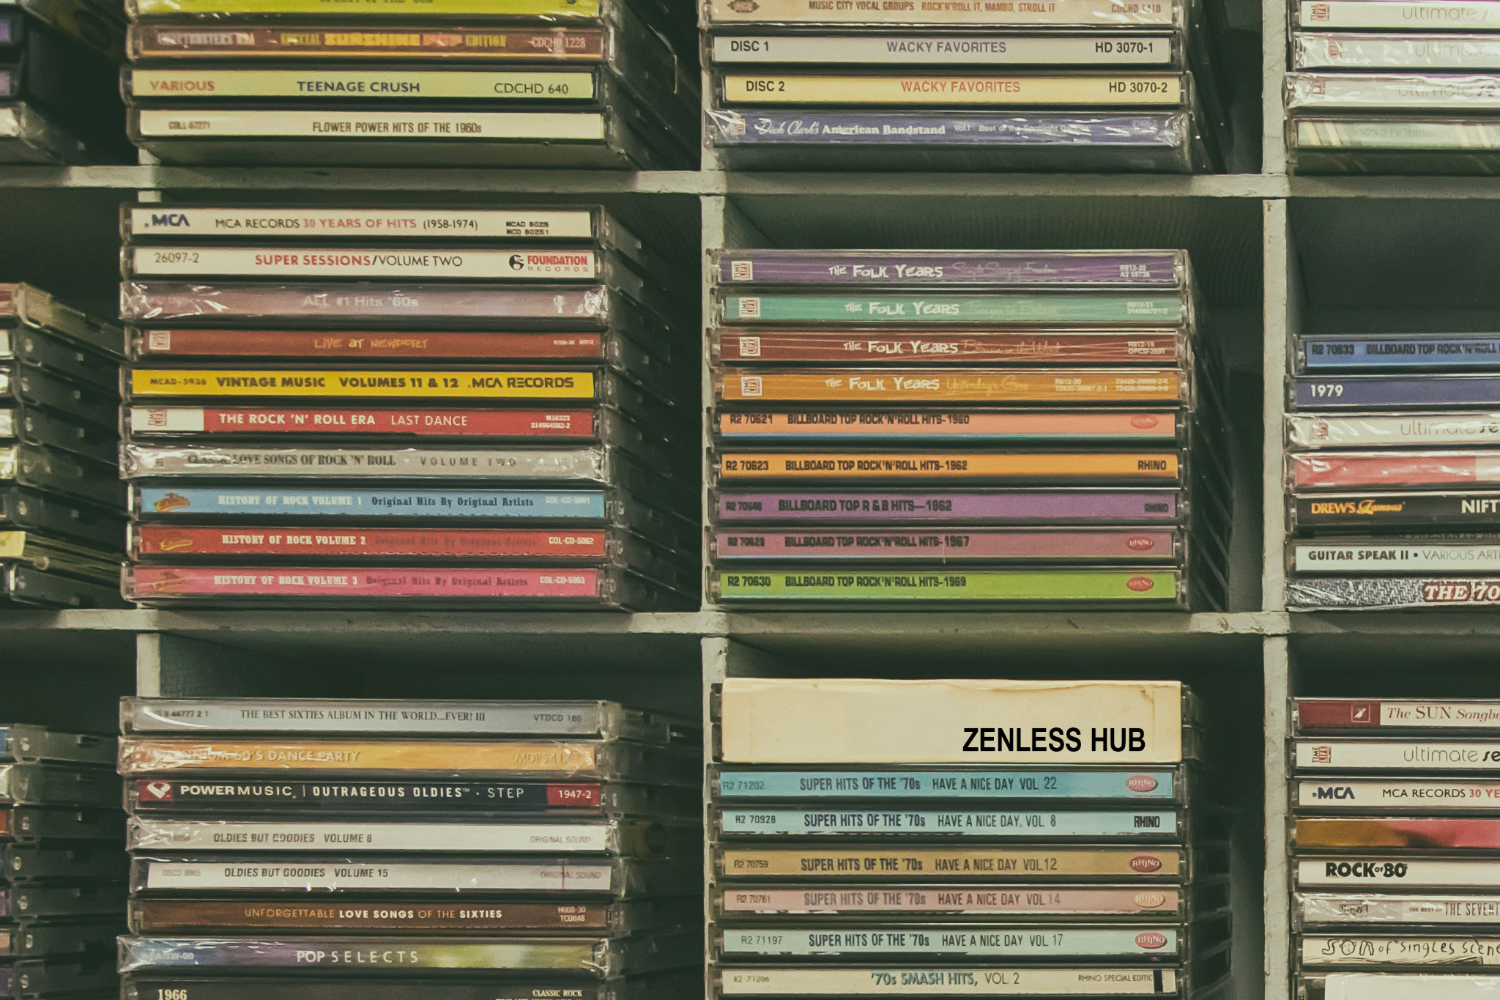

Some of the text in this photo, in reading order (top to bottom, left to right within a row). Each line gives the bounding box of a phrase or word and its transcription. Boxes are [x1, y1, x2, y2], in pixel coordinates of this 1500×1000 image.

[731, 41, 1152, 53] DISC 1 WACKY FAVORITES HD 3070-1
[150, 81, 568, 94] VARIOUS TEENAGE CRUSH CDCHD 640
[155, 253, 462, 266] 26097-2 SUPER SESSIONS/VOLUME TWO
[528, 256, 587, 265] FOUNDATION
[829, 264, 943, 278] THE FOLK YEARS
[217, 377, 458, 387] VINTAGE MUSIC VOLUMES 11 & 12
[1311, 385, 1343, 397] 1979
[1387, 707, 1411, 720] The
[1416, 707, 1450, 718] SUN
[963, 727, 1145, 752] ZENLESS HUB
[1404, 746, 1478, 762] ultimate
[245, 909, 502, 918] UNFORGETTABLE LOVE SONGS OF THE SIXTIES
[158, 989, 187, 1000] 1966
